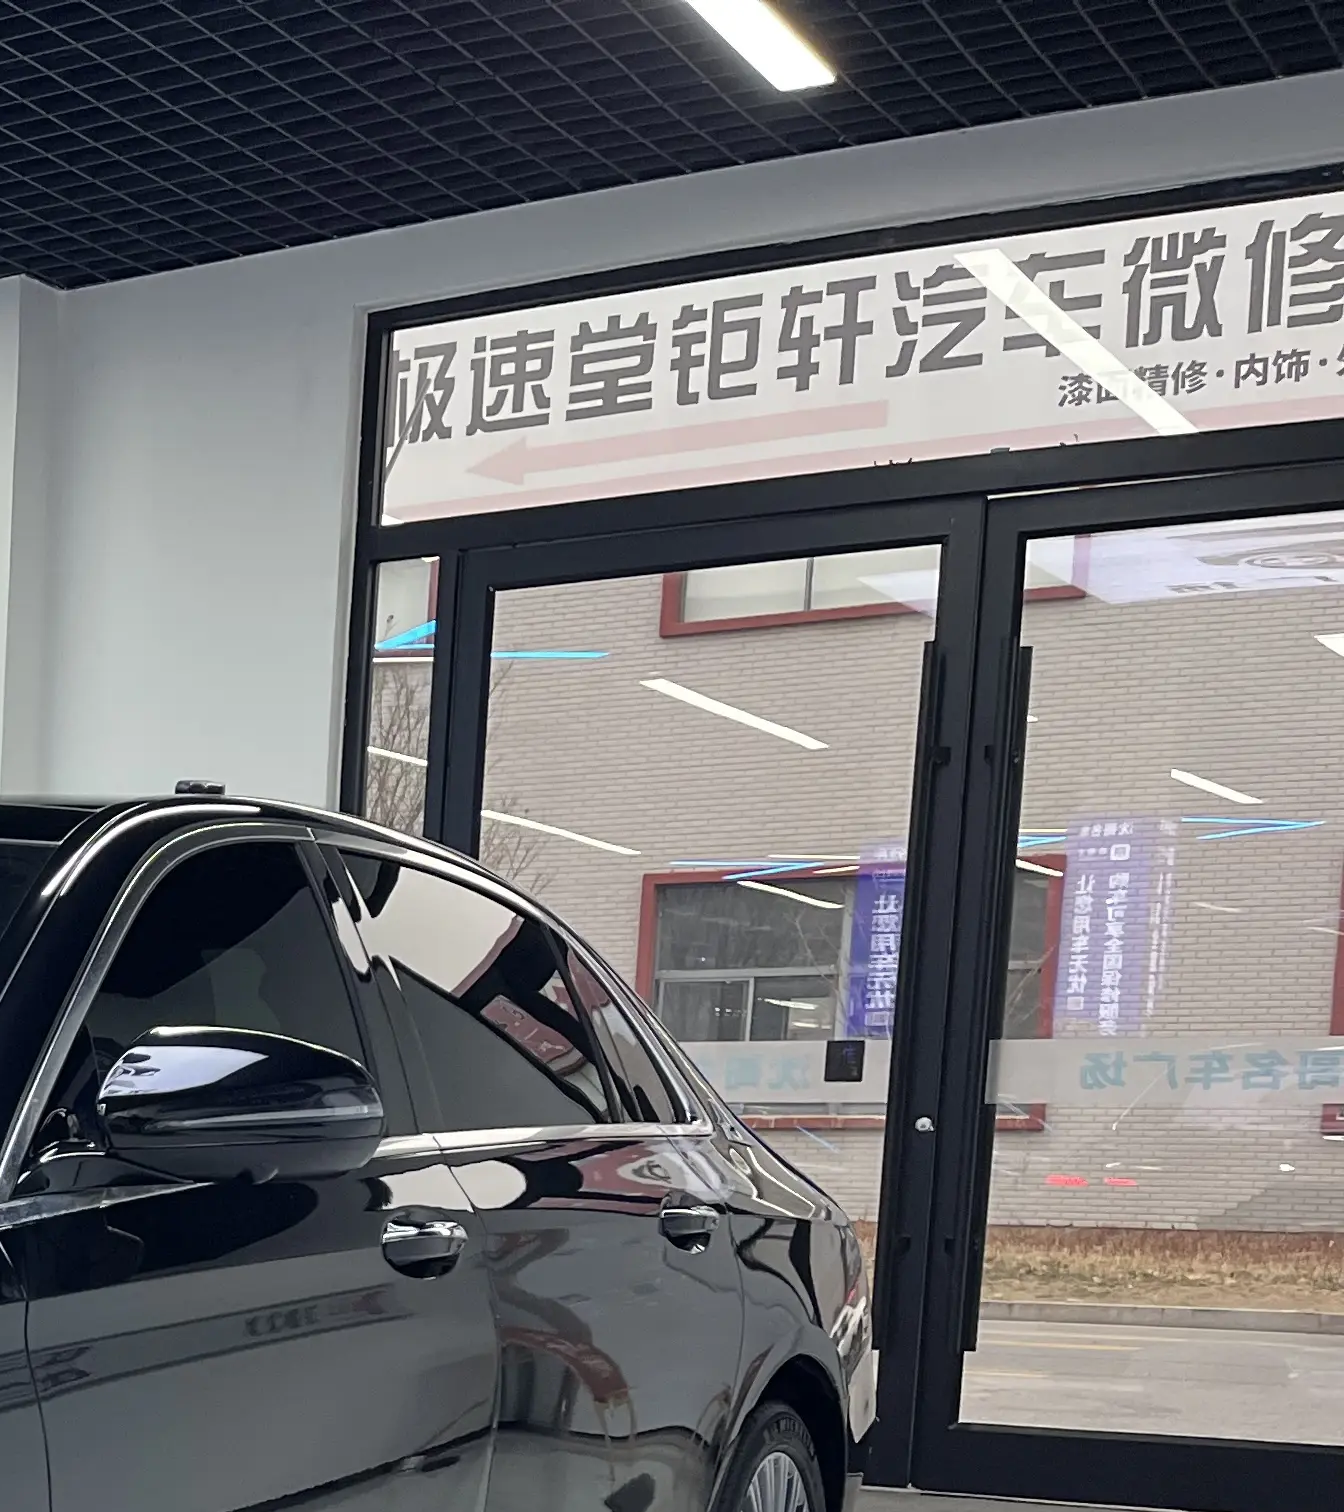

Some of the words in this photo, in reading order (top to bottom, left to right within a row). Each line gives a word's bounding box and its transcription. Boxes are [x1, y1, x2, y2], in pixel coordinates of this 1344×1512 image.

[1057, 349, 1344, 408] 漆面精修·内饰·
